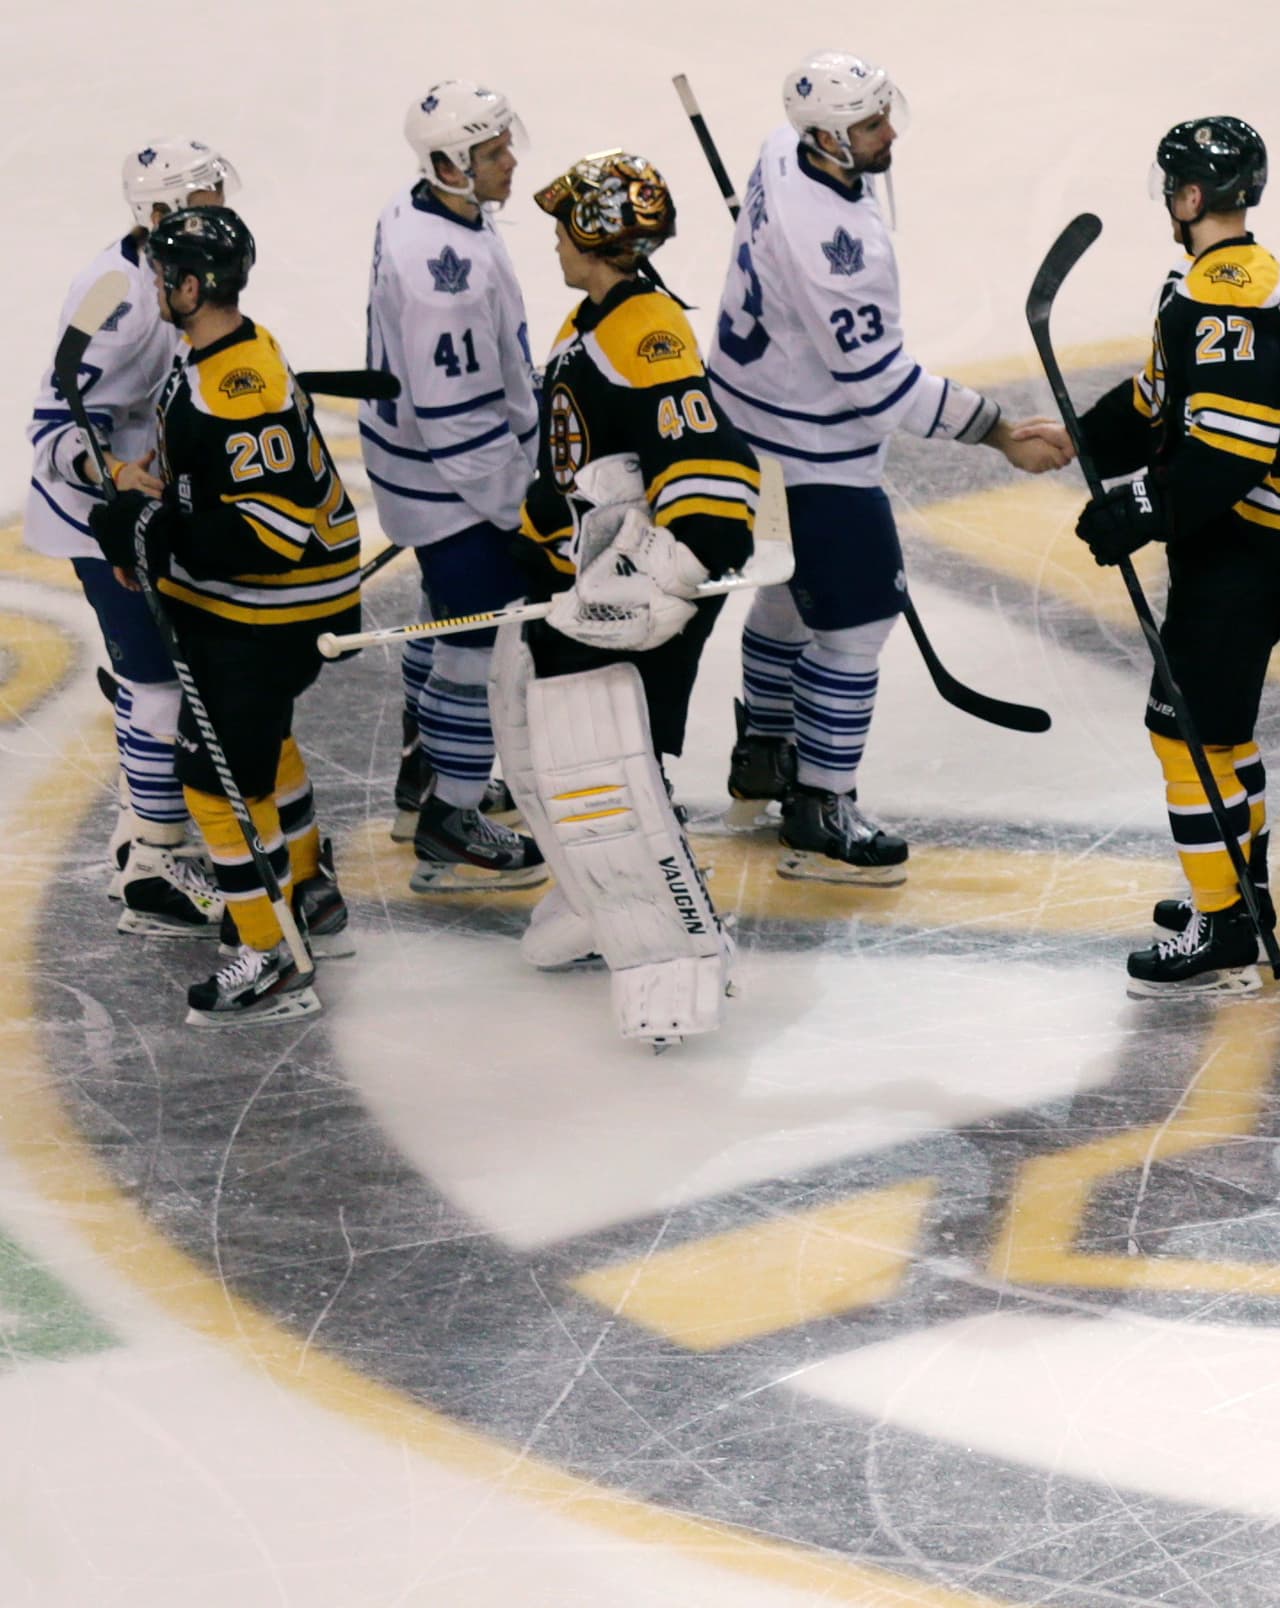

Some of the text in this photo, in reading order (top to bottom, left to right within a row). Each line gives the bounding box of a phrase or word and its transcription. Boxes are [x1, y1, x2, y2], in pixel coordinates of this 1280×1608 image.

[433, 328, 480, 378] 41
[829, 304, 885, 354] 23
[1195, 315, 1255, 365] 27
[657, 389, 718, 440] 40
[226, 424, 295, 483] 20
[172, 660, 251, 824] WARRIOR
[658, 855, 707, 935] VAUGHN
